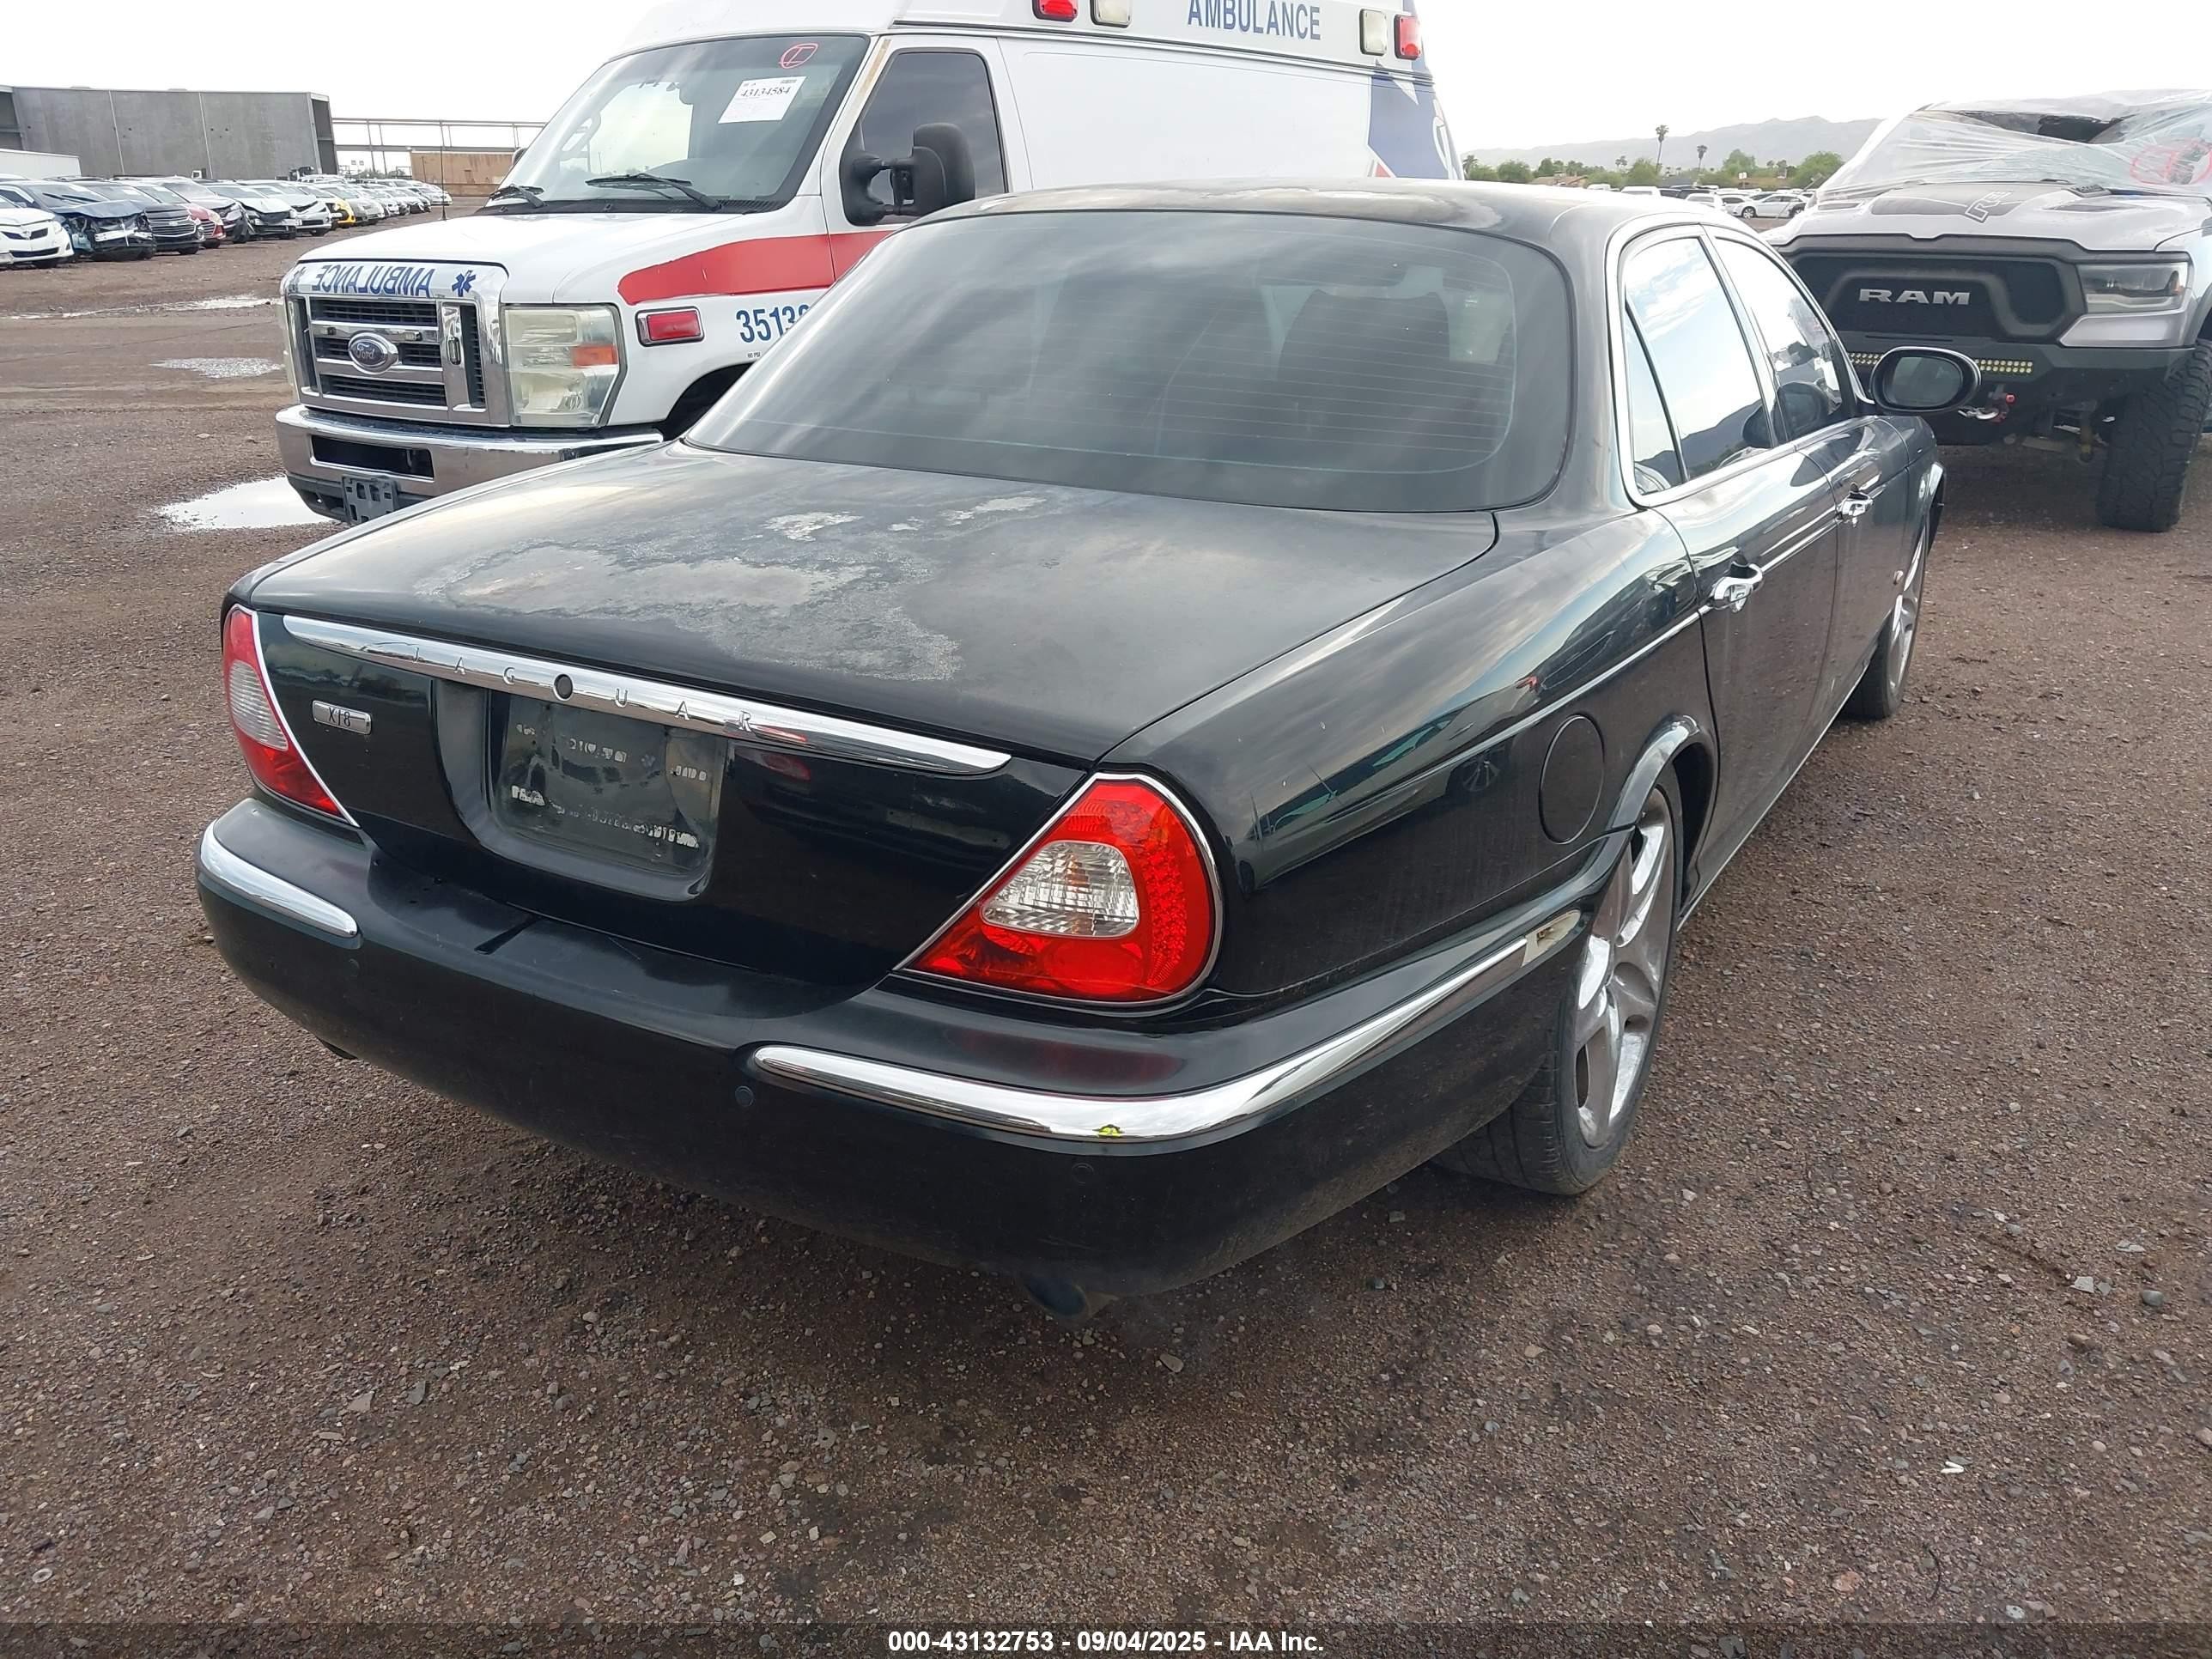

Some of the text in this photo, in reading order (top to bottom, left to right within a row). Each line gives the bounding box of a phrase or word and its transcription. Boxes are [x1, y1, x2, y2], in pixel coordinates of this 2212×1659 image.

[1188, 0, 1322, 40] AMBULANCE
[740, 86, 791, 97] 43134584
[1858, 289, 1970, 305] RAM
[356, 343, 376, 359] Ford
[412, 647, 753, 732] JAGUAR
